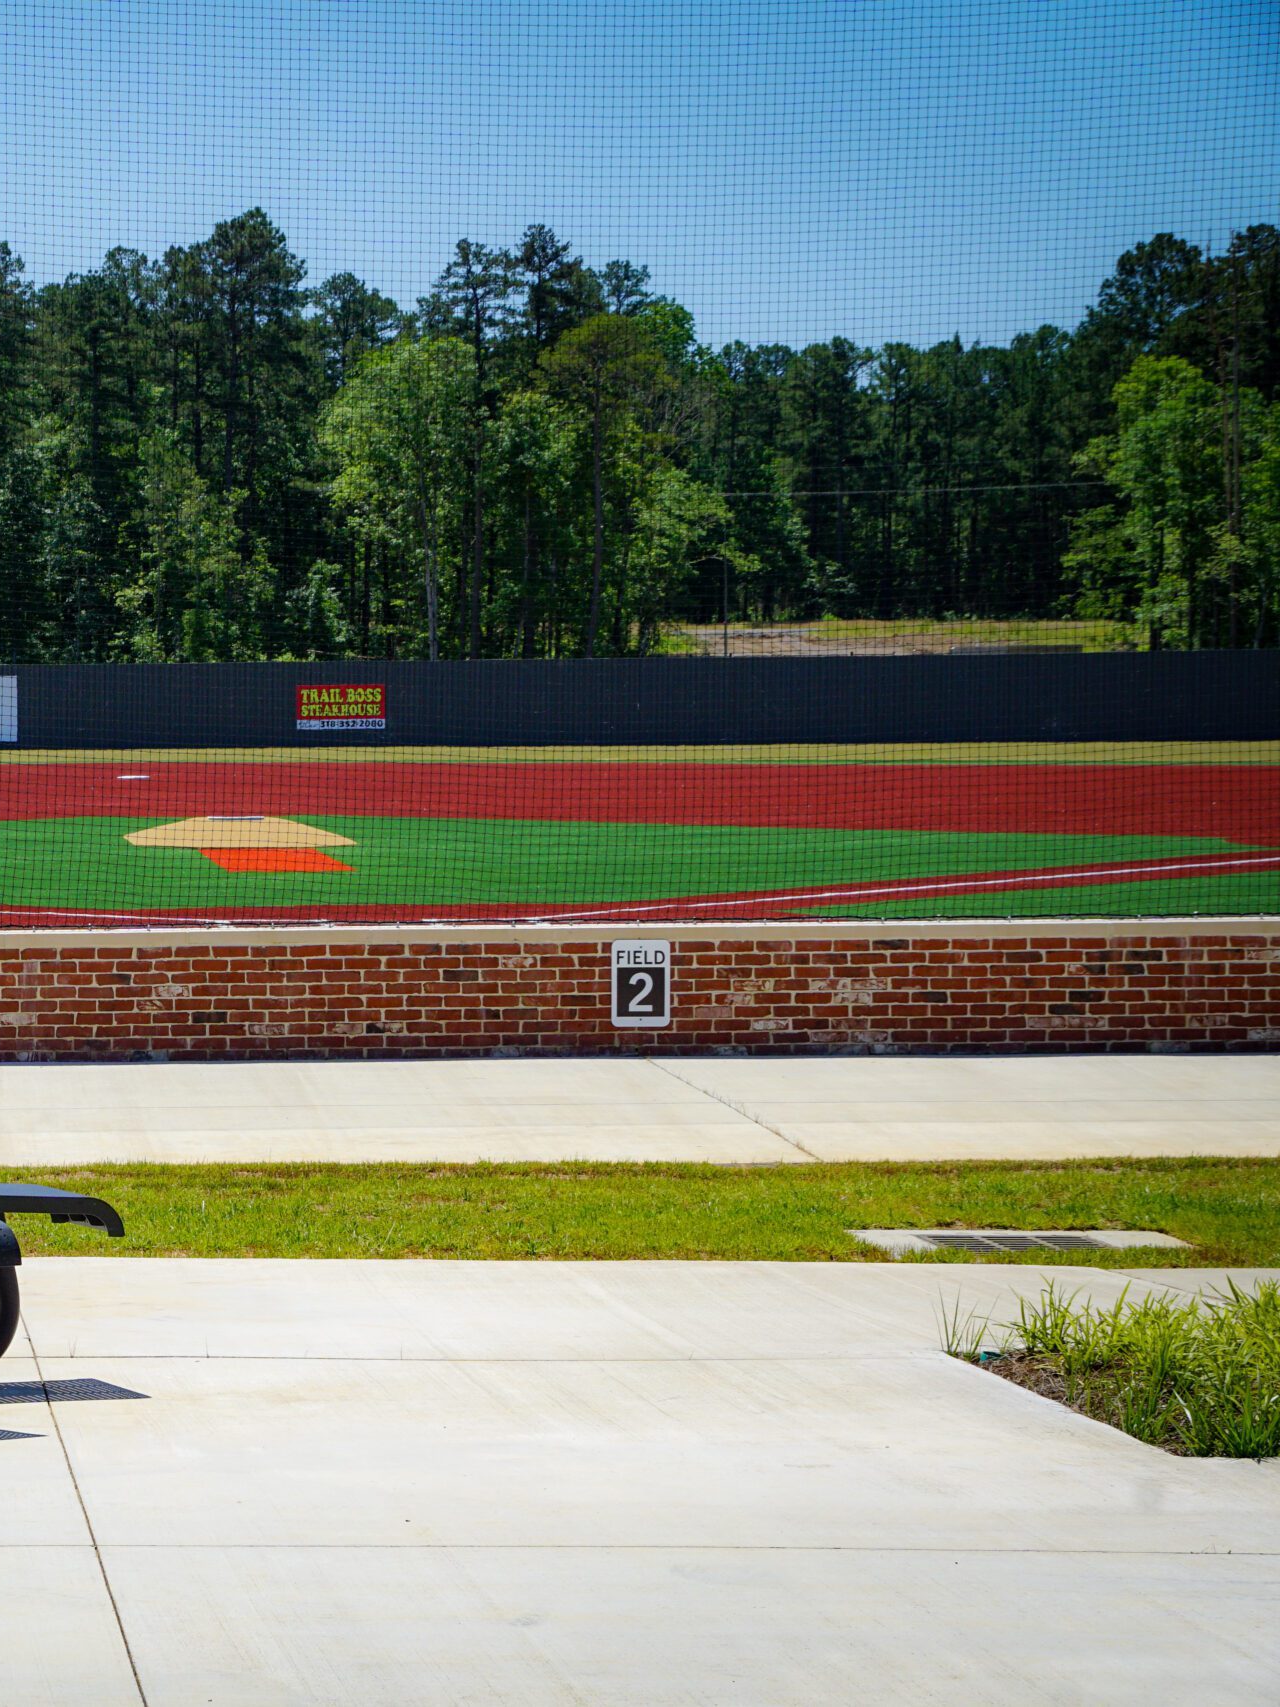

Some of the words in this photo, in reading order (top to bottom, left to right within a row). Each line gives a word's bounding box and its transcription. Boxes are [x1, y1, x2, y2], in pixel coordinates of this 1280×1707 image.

[301, 689, 343, 703] TRAIL
[346, 688, 382, 702] BOSS
[301, 704, 381, 716] STEAKHOUSE
[617, 950, 665, 964] FIELD
[628, 972, 654, 1012] 2
